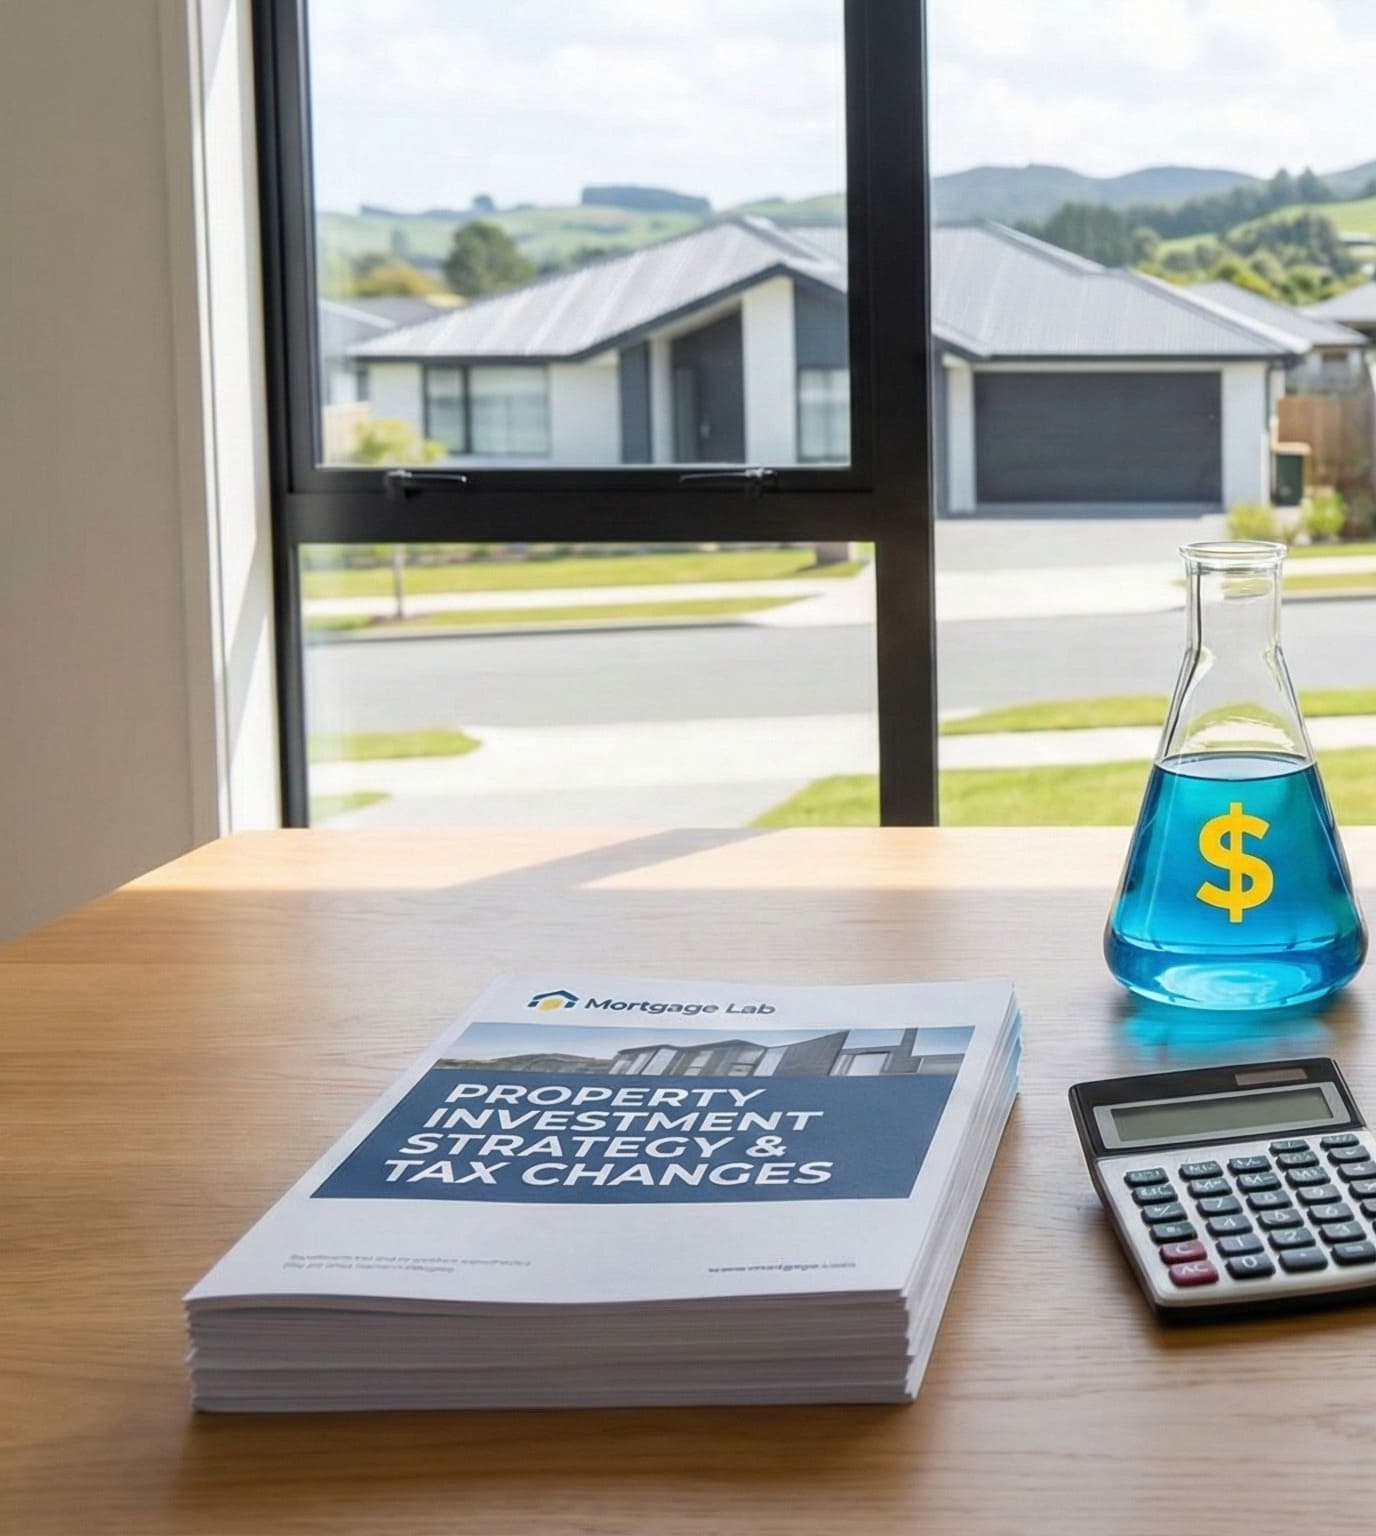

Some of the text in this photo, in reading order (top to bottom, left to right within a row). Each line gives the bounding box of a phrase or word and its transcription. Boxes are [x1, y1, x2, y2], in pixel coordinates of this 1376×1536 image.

[585, 998, 776, 1015] Mortgage Lab
[445, 1084, 766, 1107] PROPERTY
[423, 1108, 824, 1132] INVESTMENT
[399, 1133, 788, 1158] STRATEGY &
[383, 1160, 834, 1186] TAX CHANGES
